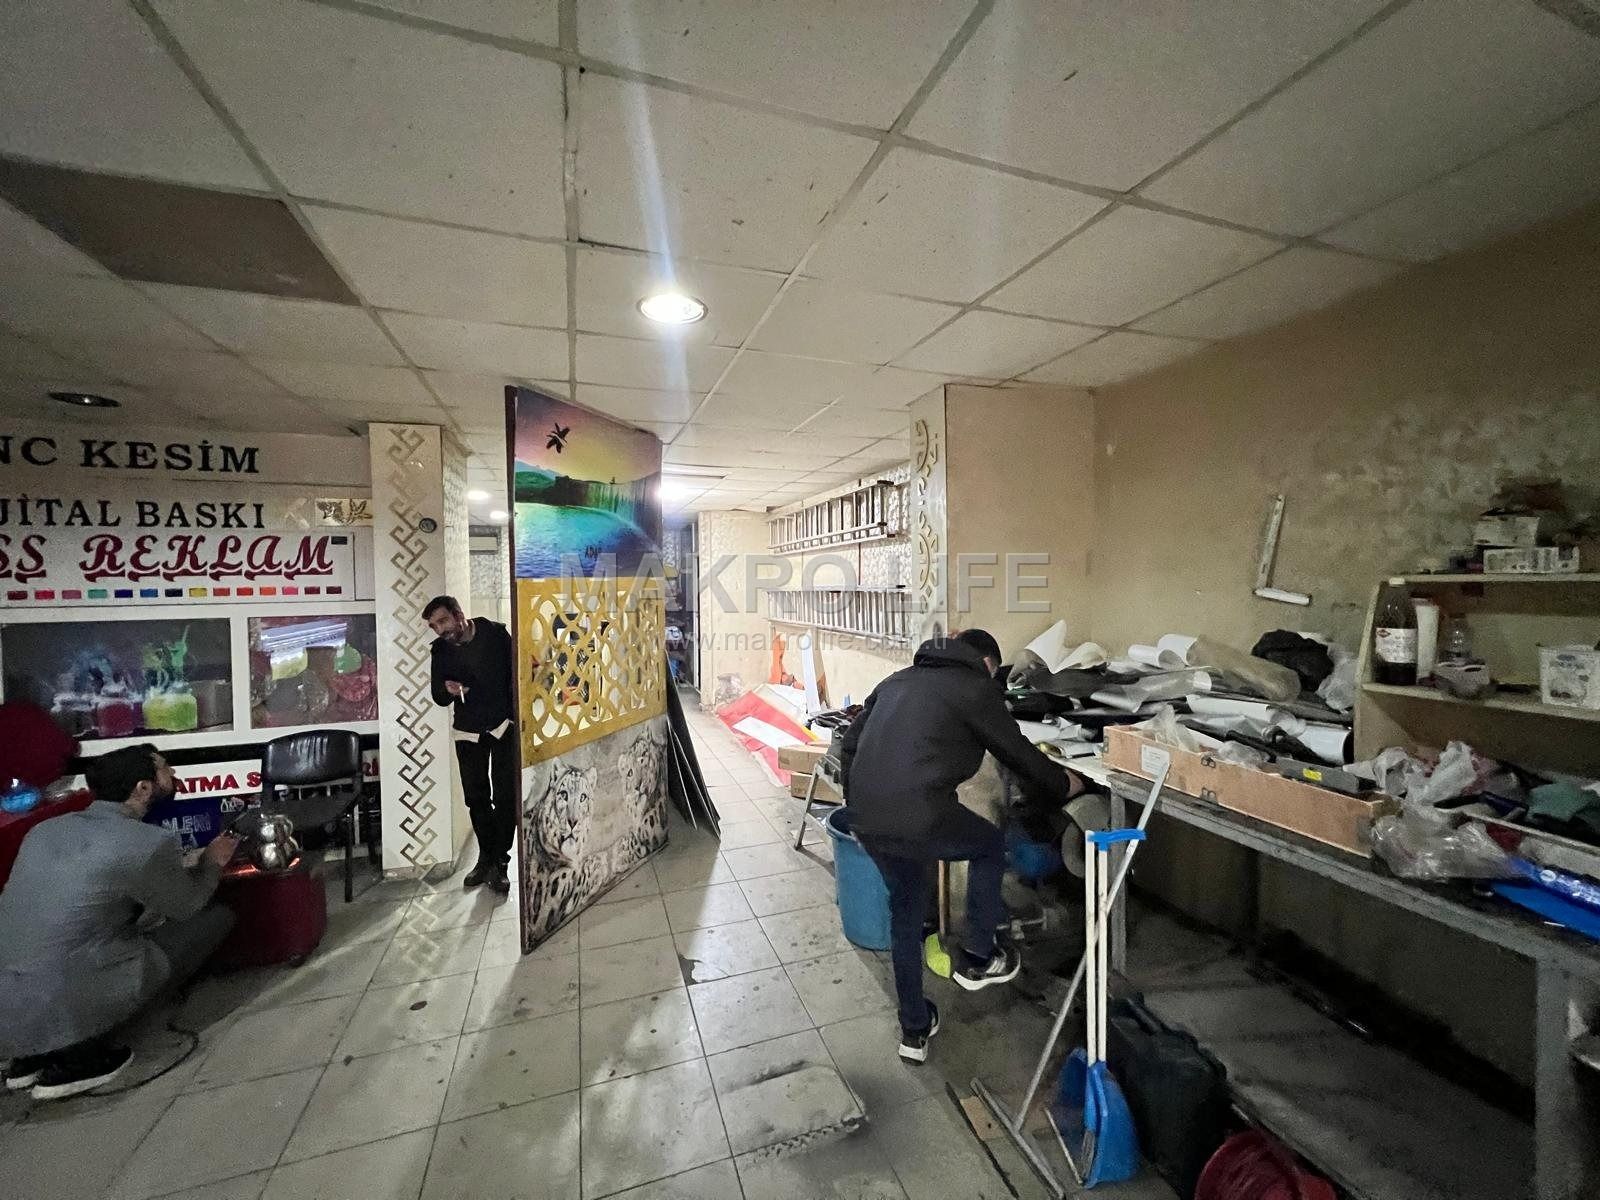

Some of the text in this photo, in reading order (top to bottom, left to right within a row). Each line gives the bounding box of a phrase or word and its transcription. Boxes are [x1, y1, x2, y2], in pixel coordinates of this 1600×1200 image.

[80, 440, 260, 473] KESİM
[136, 501, 265, 529] BASKI
[79, 534, 333, 583] REKLAM
